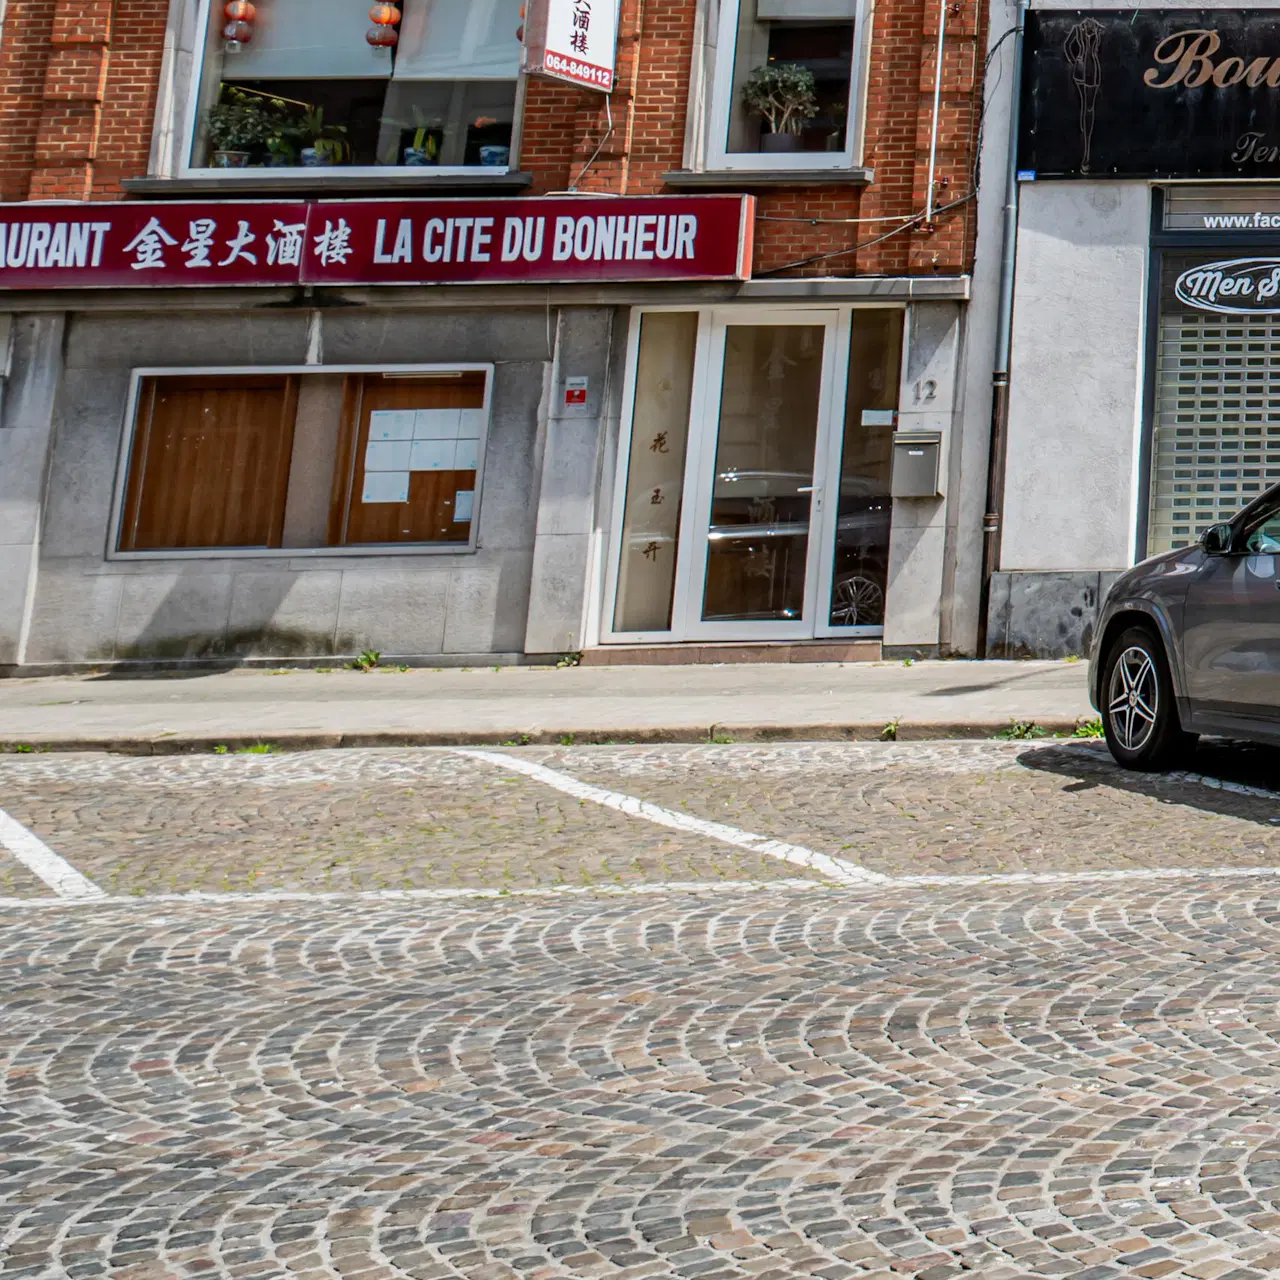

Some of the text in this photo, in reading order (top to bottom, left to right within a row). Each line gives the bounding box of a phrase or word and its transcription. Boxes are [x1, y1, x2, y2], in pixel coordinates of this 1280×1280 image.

[546, 54, 610, 85] 064-849112
[0, 221, 112, 269] URANT
[373, 218, 413, 264] LA
[422, 216, 495, 263] CITE
[500, 215, 546, 262] DU
[552, 214, 698, 261] BONHEUR
[1184, 268, 1255, 301] Men
[913, 379, 938, 400] 12
